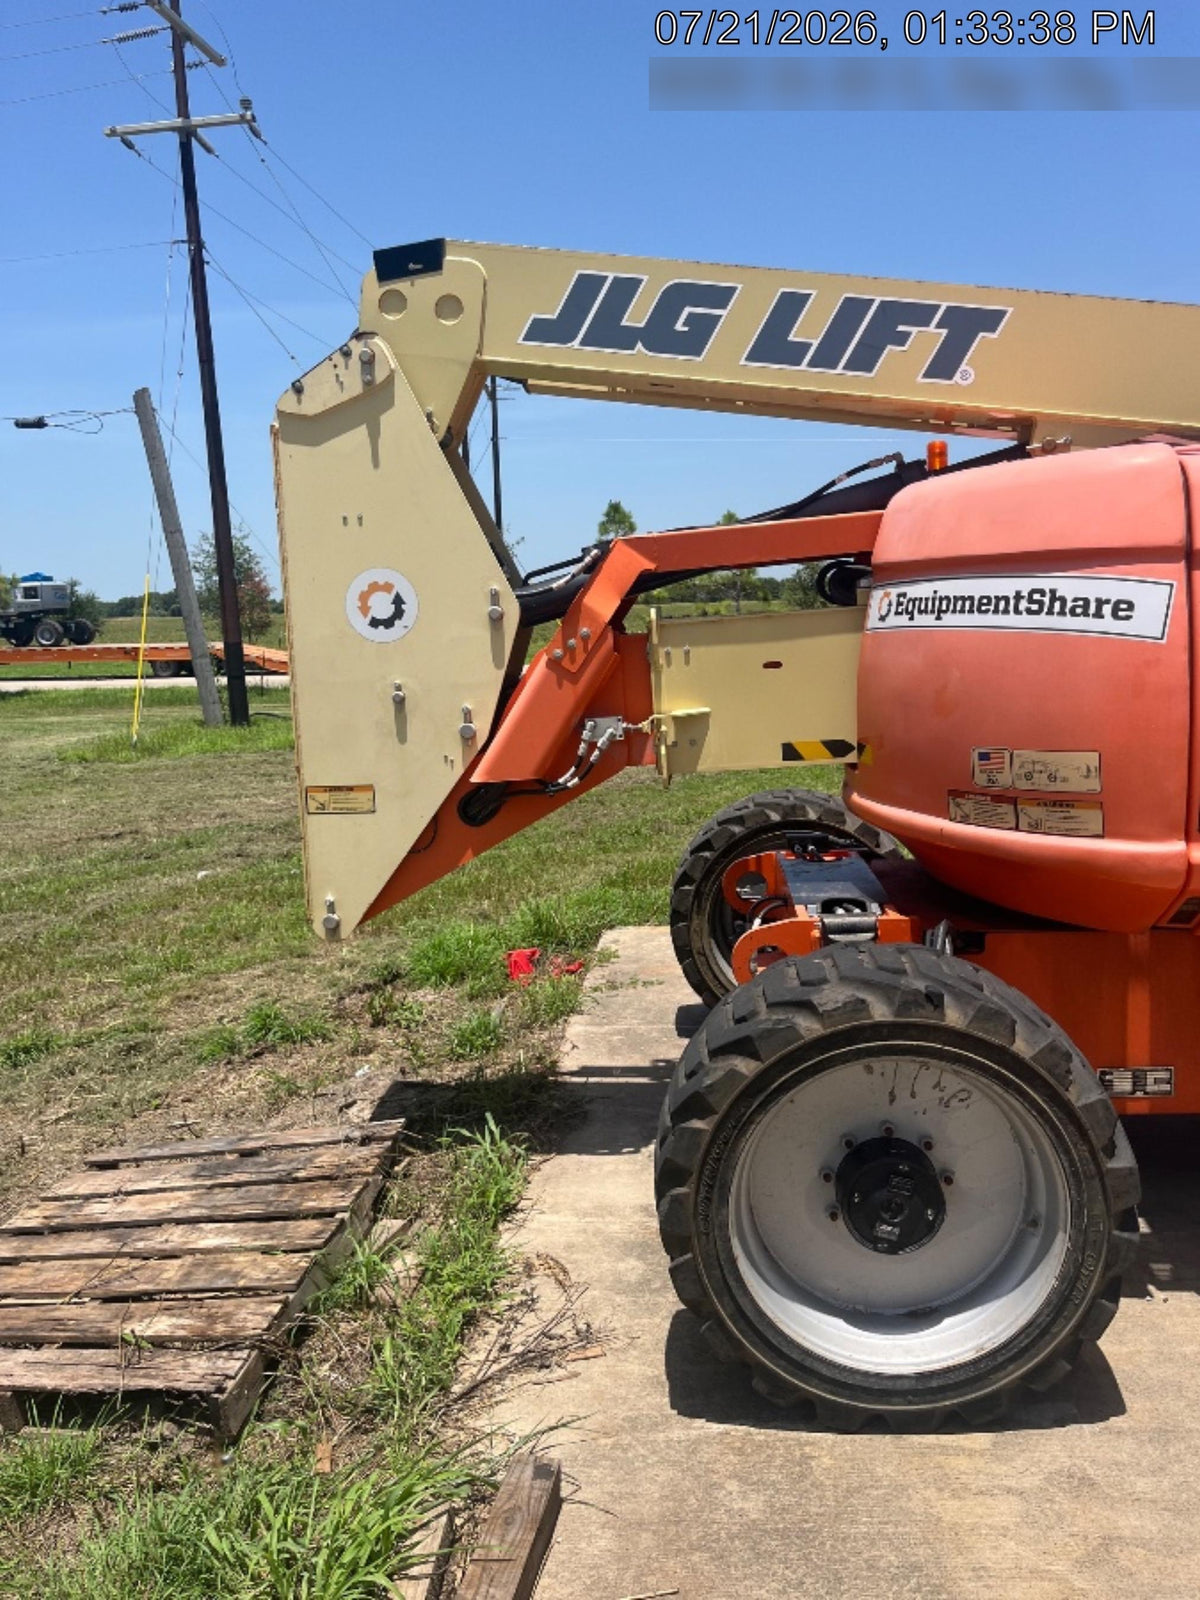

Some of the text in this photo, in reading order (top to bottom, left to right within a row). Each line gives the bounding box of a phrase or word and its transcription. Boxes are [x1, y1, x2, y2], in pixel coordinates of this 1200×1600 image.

[517, 269, 1013, 384] JLG LIFT
[894, 588, 1135, 621] EquipmentShare
